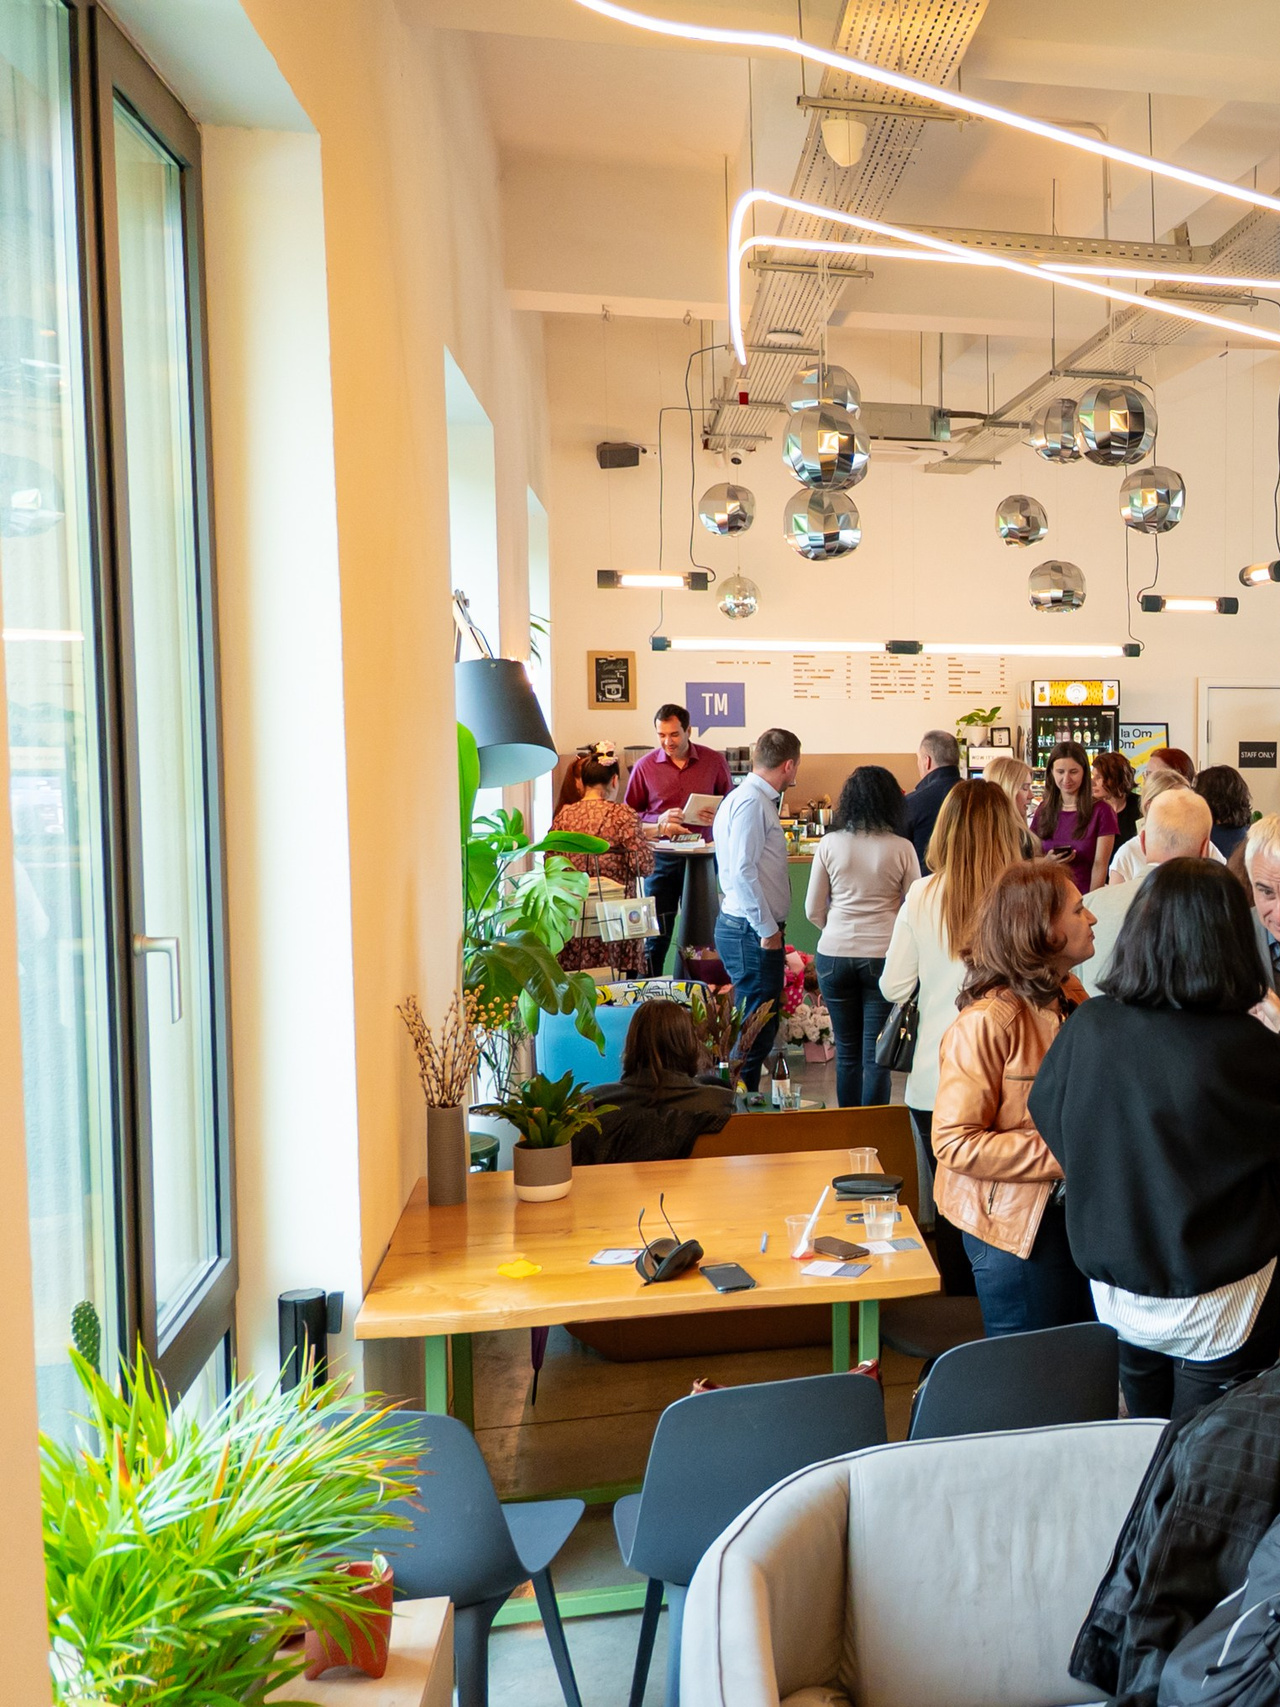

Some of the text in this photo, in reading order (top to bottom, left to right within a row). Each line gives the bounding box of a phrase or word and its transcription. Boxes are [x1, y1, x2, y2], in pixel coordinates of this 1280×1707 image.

[701, 692, 728, 716] TM
[1132, 728, 1152, 738] Om
[1240, 751, 1275, 759] STAFF ONLY
